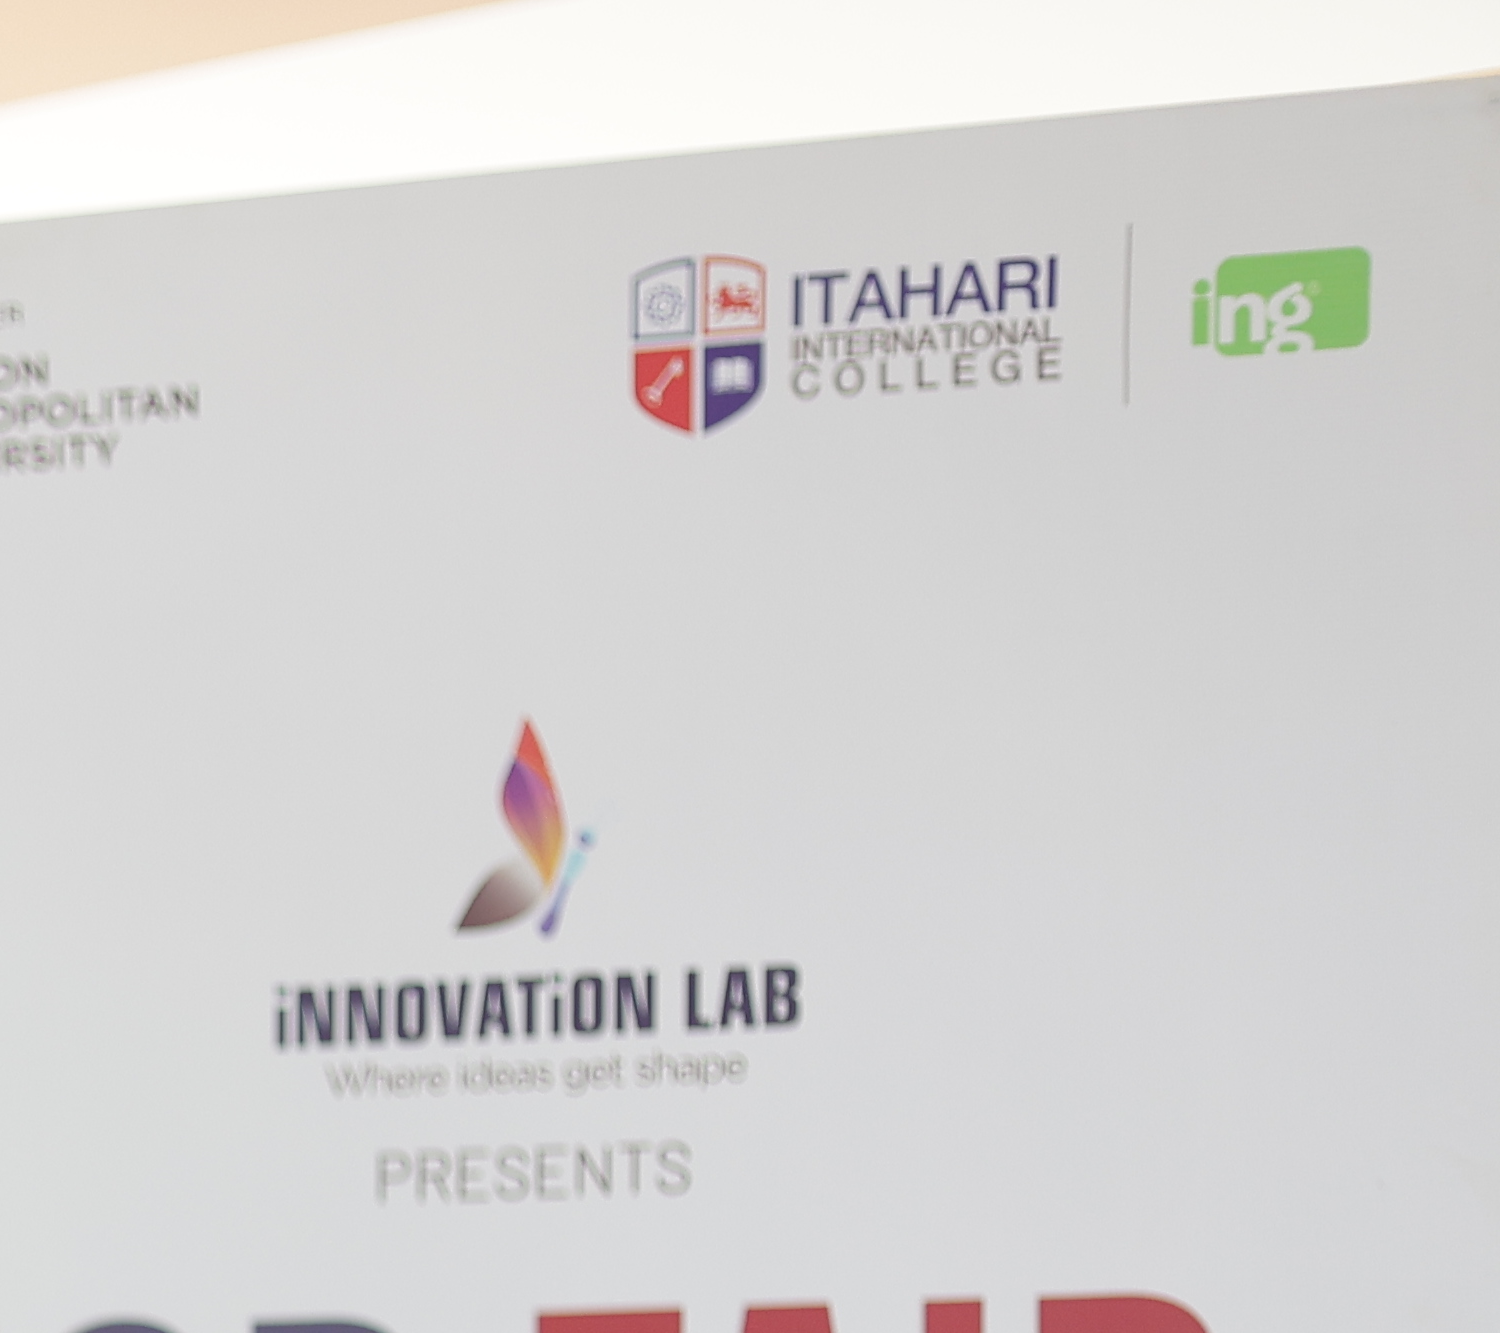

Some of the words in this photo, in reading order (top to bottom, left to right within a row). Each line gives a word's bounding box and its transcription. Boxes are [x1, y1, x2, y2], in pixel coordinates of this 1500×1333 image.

[792, 255, 1059, 327] ITAHARI
[792, 316, 1060, 362] INTERNATIONAL
[792, 344, 1062, 400] COLLEGE
[684, 964, 800, 1031] LAB
[327, 1061, 448, 1099] Where
[461, 1056, 552, 1092] ideas
[562, 1054, 623, 1097] get
[638, 1049, 749, 1091] shape
[375, 1140, 695, 1205] PRESENTS
